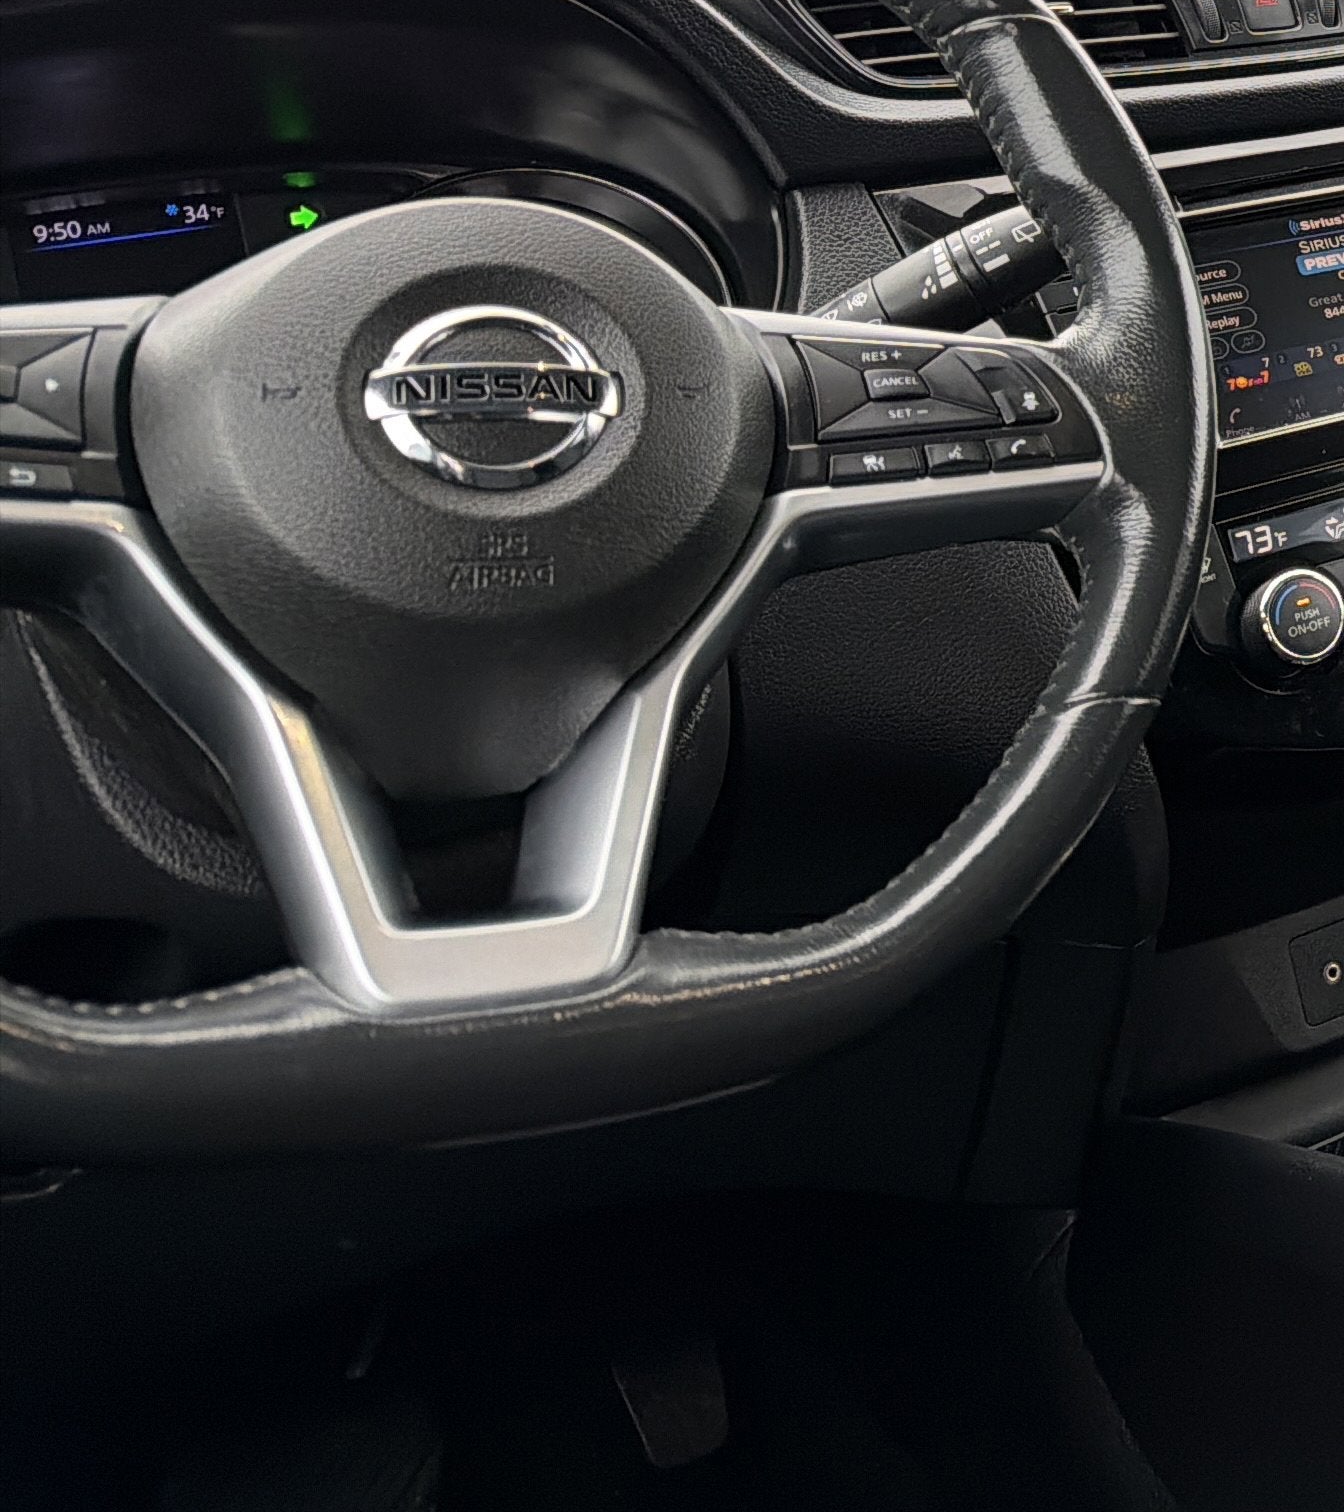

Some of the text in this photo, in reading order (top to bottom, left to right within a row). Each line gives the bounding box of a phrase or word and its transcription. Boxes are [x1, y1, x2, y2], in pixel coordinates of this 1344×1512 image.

[33, 220, 111, 244] 9:50 AM
[970, 227, 994, 245] OFF
[1211, 290, 1243, 304] Menu
[1308, 292, 1344, 308] Great
[861, 350, 888, 363] RES
[1306, 345, 1324, 359] 73
[392, 373, 598, 405] NISSAN
[873, 375, 919, 388] CANCEL
[888, 407, 912, 419] SET
[1294, 607, 1320, 622] PUSH
[1287, 615, 1331, 638] ON-OFF
